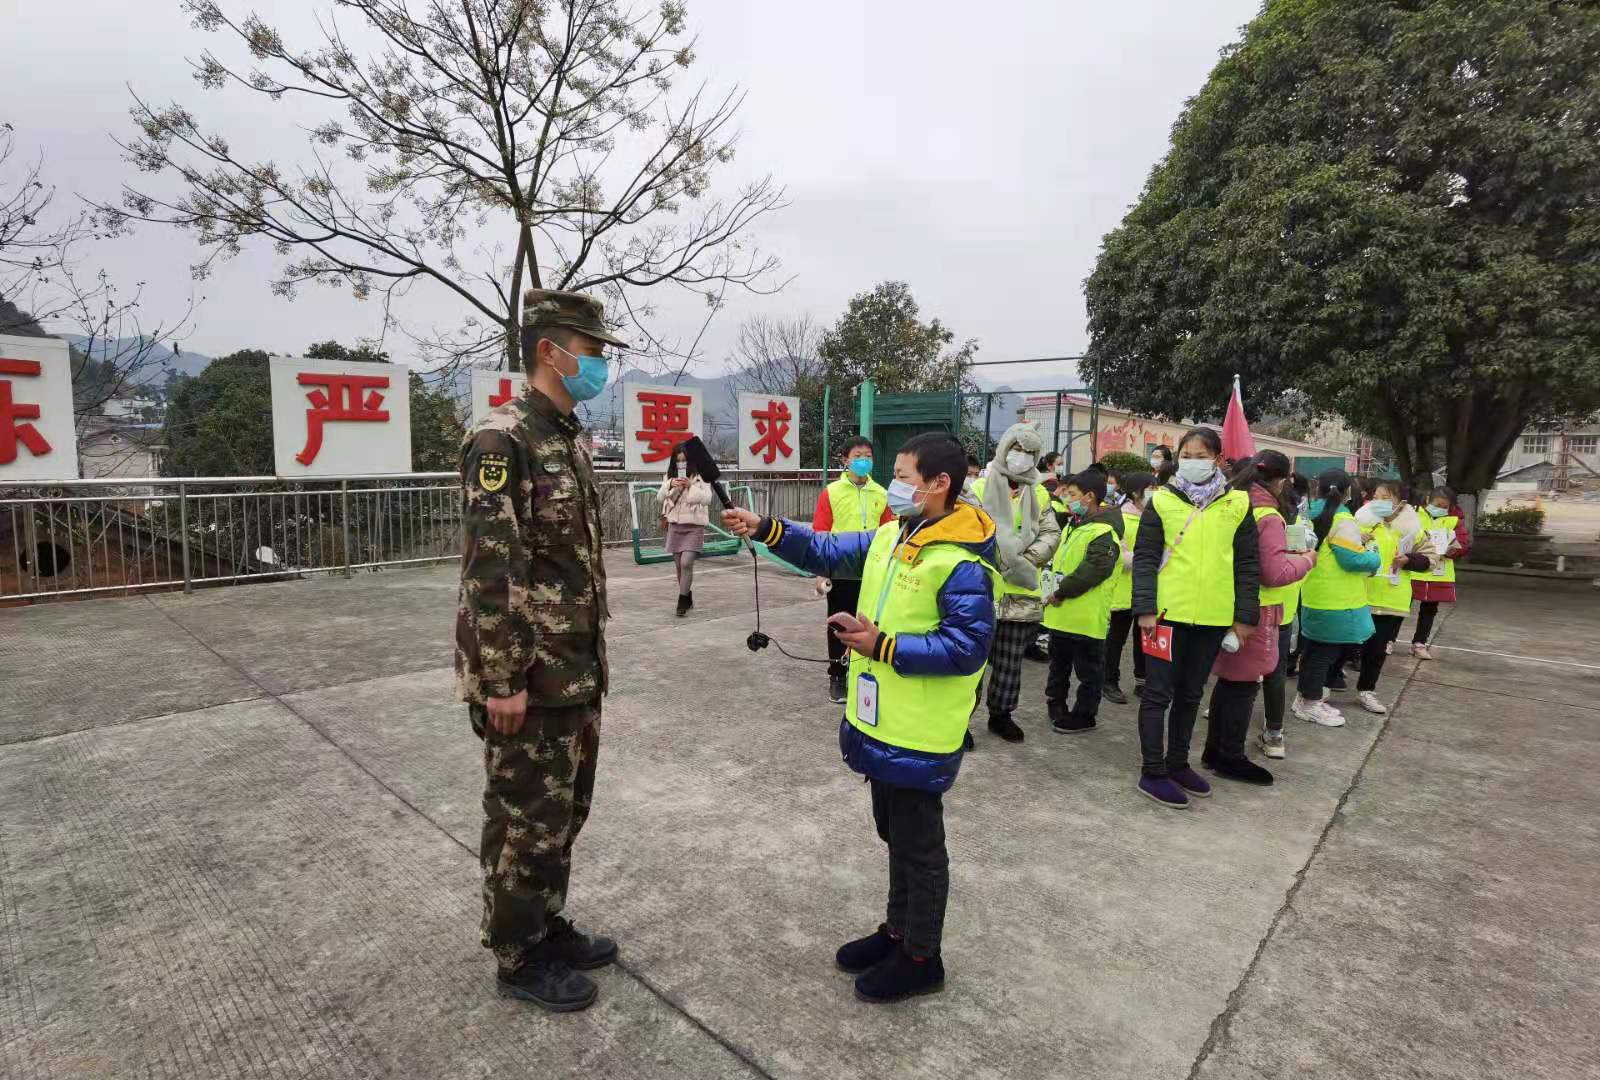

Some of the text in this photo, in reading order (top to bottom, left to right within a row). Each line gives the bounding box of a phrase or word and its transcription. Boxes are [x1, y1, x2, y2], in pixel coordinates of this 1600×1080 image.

[296, 372, 390, 466] 严
[635, 392, 694, 464] 要
[749, 399, 794, 464] 求
